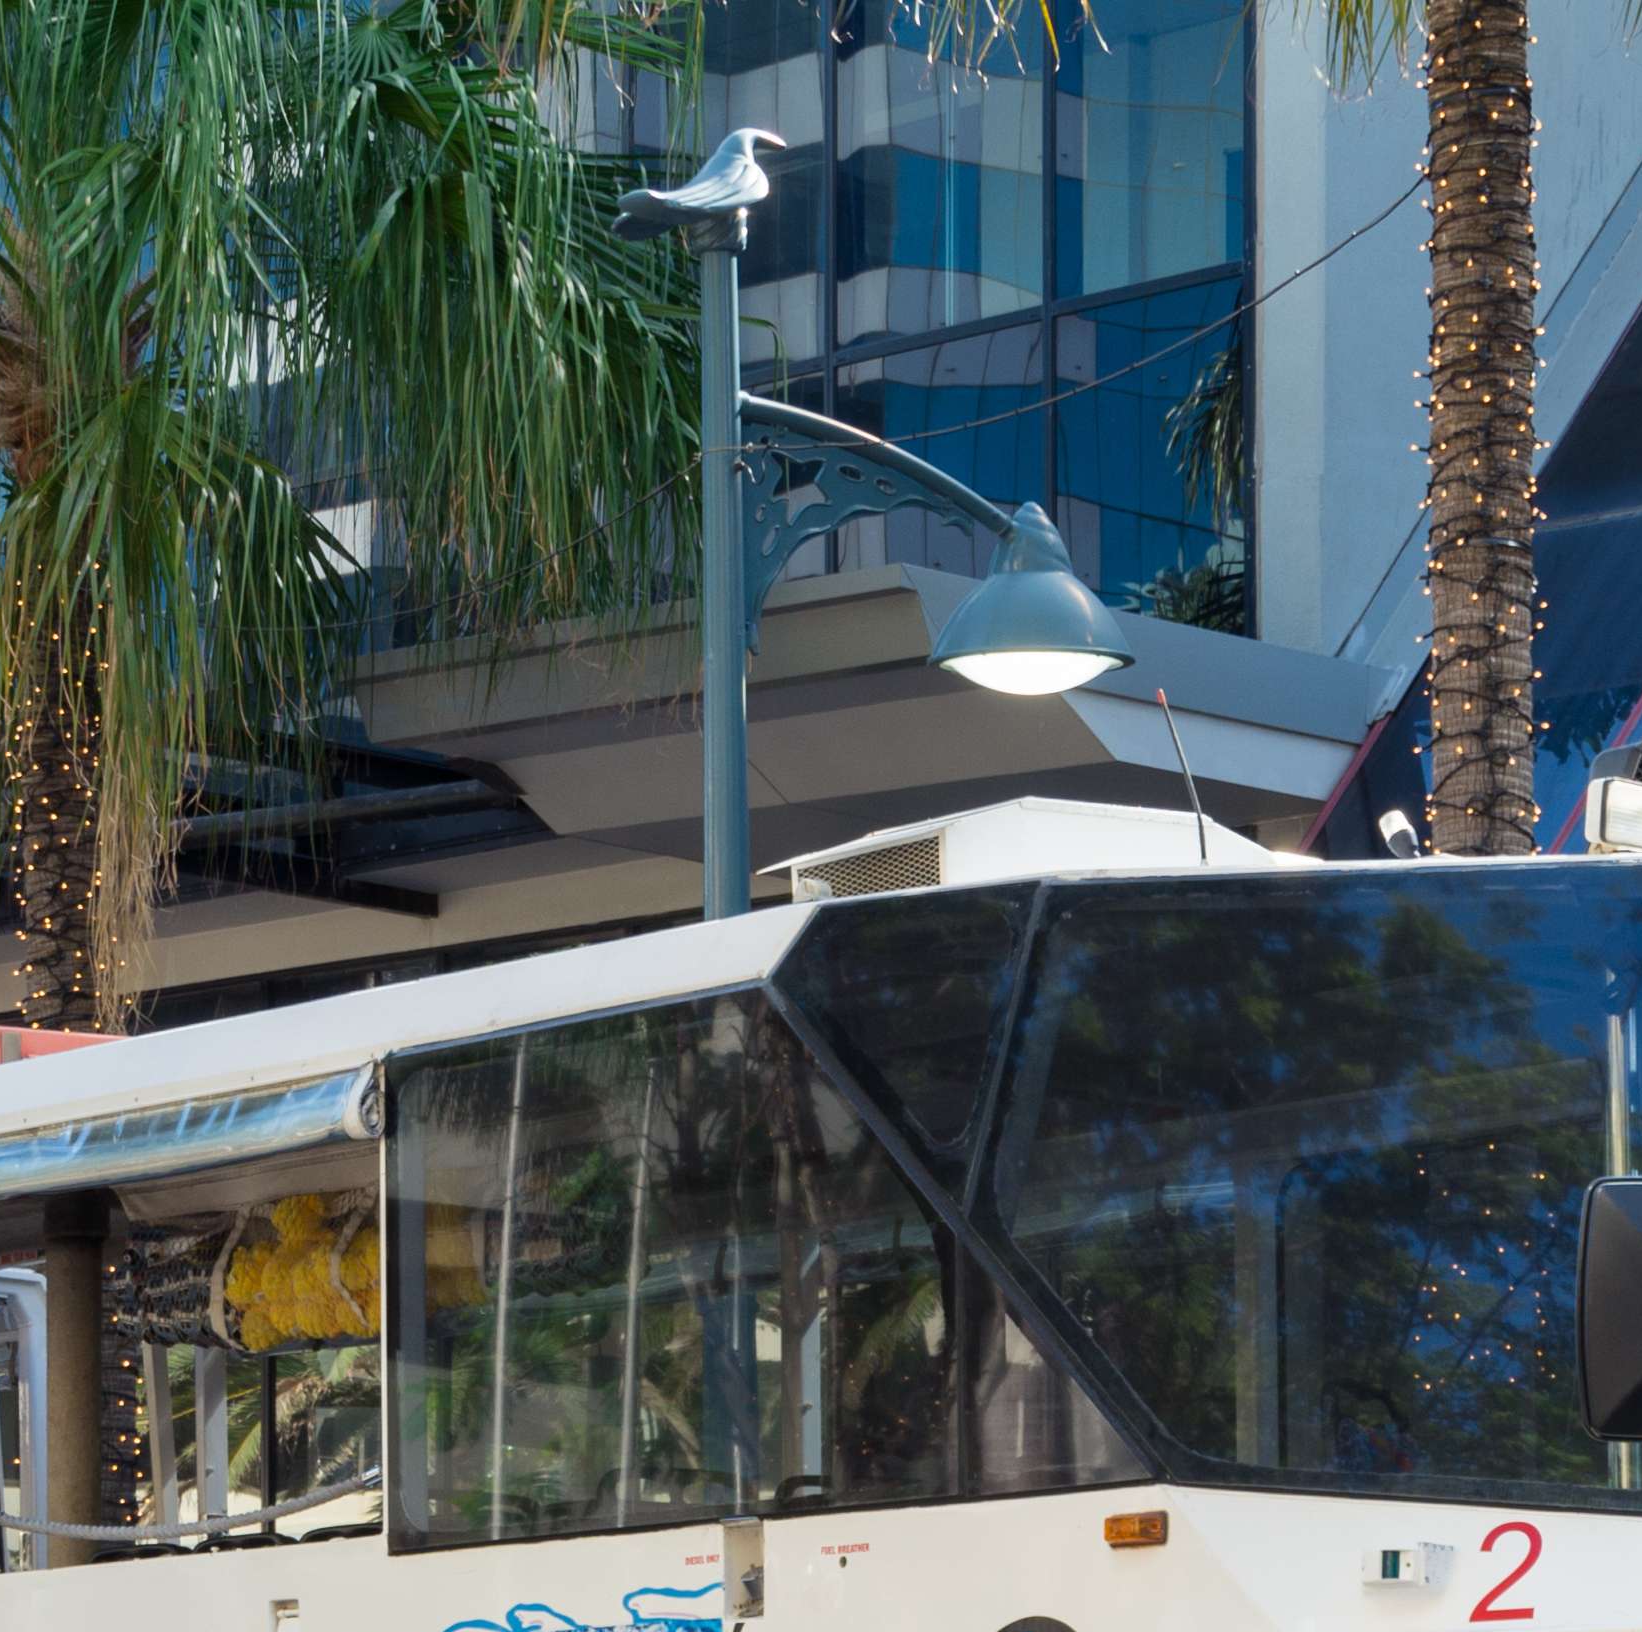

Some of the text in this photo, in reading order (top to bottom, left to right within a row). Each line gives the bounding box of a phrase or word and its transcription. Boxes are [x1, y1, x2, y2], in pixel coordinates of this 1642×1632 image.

[820, 1542, 870, 1555] FUEL BREATHER
[685, 1555, 705, 1566] DIESEL
[1468, 1521, 1544, 1623] 2
